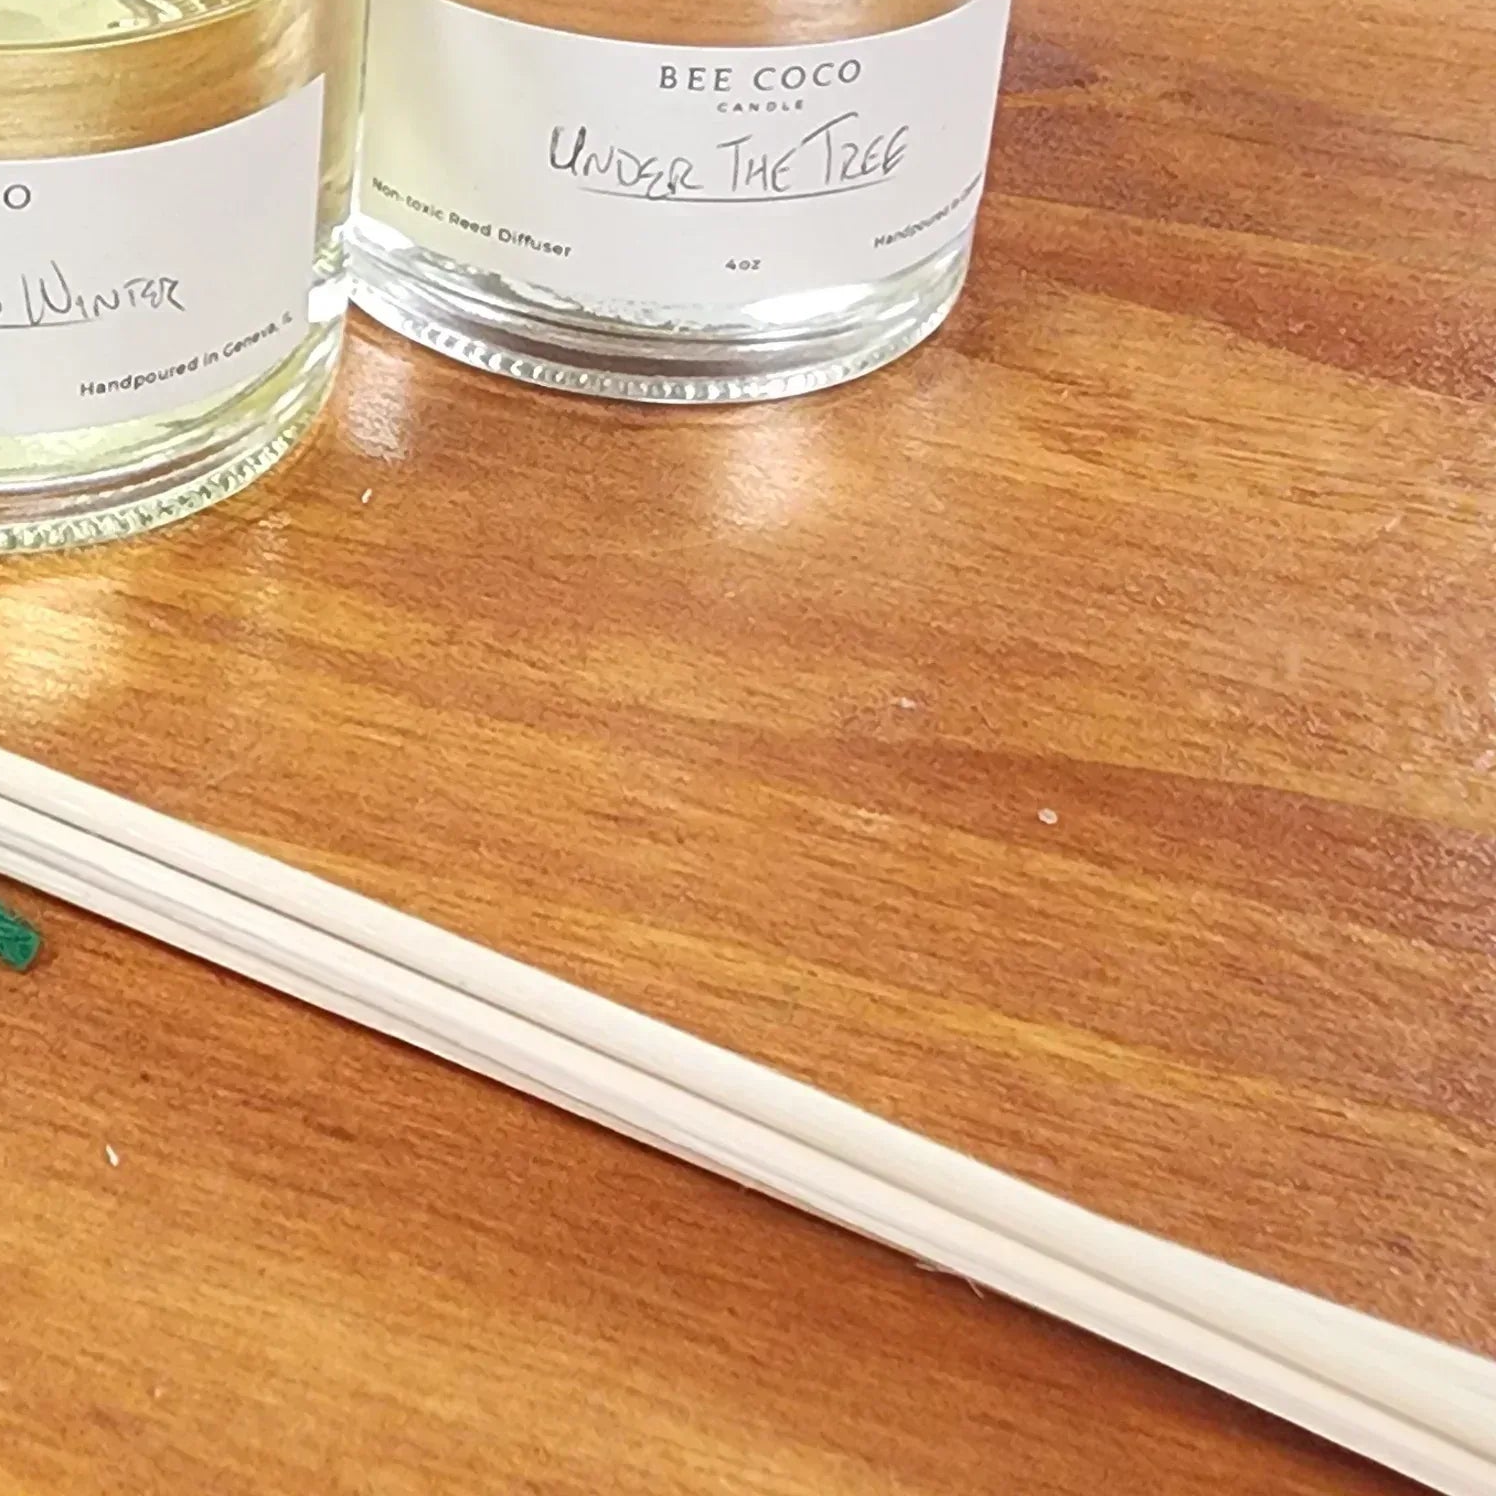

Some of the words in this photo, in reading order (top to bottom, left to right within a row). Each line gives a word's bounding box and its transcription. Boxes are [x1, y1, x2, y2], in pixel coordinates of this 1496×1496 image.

[659, 64, 733, 92] BEE
[753, 58, 862, 92] COCO
[716, 98, 804, 114] CANDLE
[549, 125, 705, 201] UNDER
[715, 133, 797, 193] THE
[799, 111, 910, 186] TREE
[372, 177, 445, 221] Non-toxic
[447, 211, 492, 238] Reed
[497, 227, 572, 258] Diffuser
[20, 259, 186, 328] WINTER
[79, 356, 199, 397] Handpoured
[203, 350, 220, 367] in
